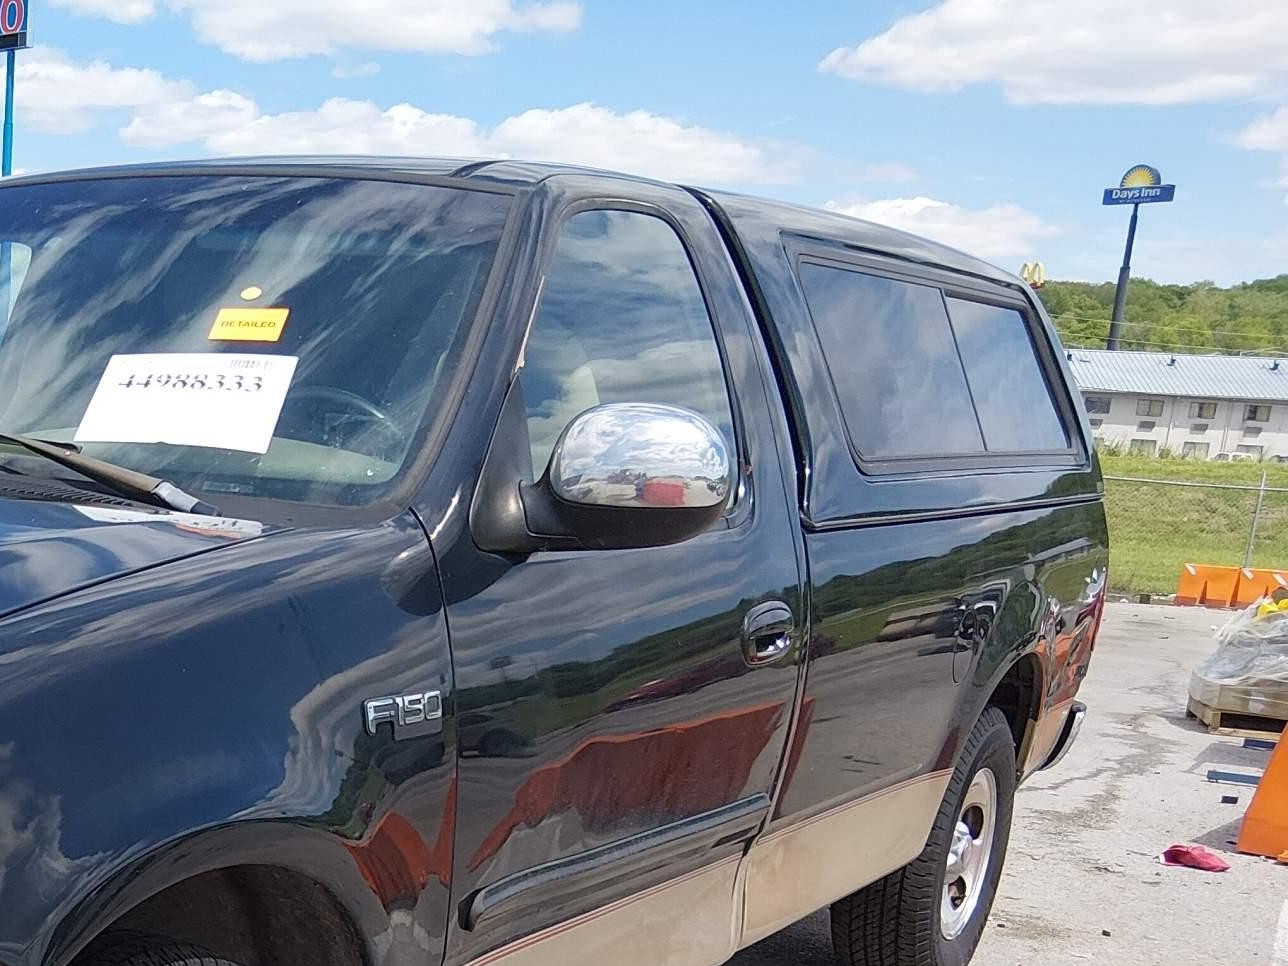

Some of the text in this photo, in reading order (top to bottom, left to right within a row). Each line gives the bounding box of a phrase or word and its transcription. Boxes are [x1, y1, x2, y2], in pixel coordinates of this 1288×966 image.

[1112, 188, 1161, 200] Days Inn
[221, 320, 276, 328] DETAILED
[118, 374, 263, 392] 44988333
